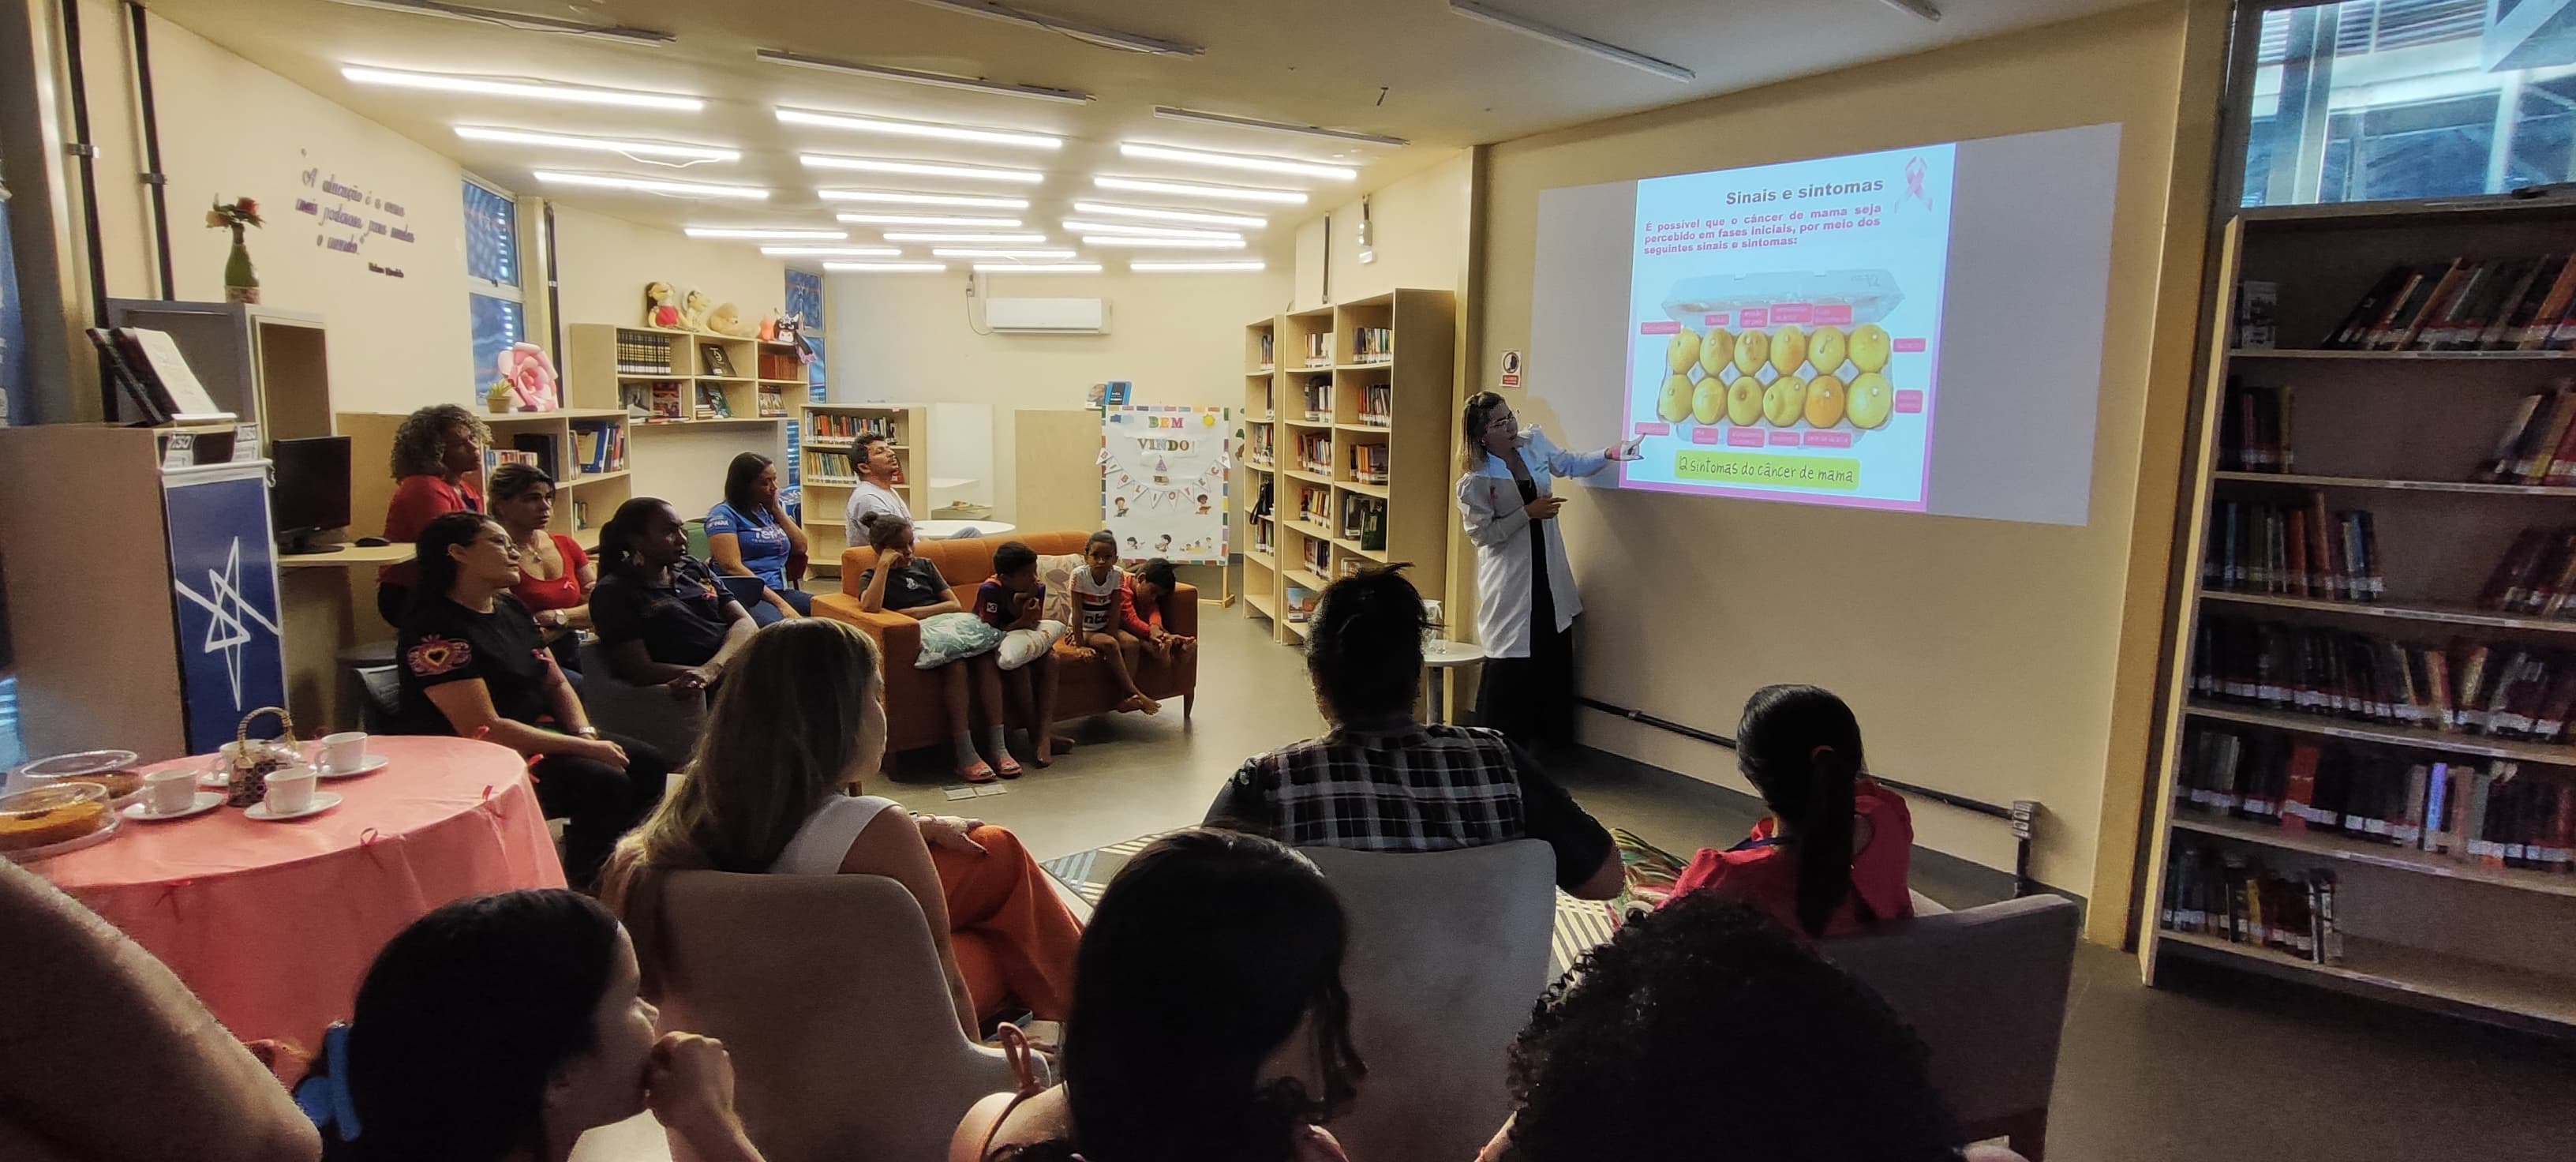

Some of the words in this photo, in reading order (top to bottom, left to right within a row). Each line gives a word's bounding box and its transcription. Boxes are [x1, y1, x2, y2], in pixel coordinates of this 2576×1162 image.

[1726, 189, 1777, 205] Sinais
[1782, 189, 1793, 200] e
[1798, 179, 1884, 198] sintomas
[1645, 231, 1696, 245] percebido
[1698, 231, 1715, 239] em
[1718, 228, 1748, 238] fases
[1799, 222, 1820, 234] por
[1823, 219, 1854, 231] meio
[1858, 217, 1881, 227] dos
[1646, 221, 1653, 231] É
[1657, 219, 1700, 233] possível
[1705, 218, 1725, 228] que
[1743, 213, 1784, 224] câncer
[1788, 210, 1804, 220] de
[1810, 208, 1848, 219] mama
[1855, 204, 1882, 216] seja
[1644, 243, 1694, 256] seguintes
[1697, 240, 1728, 251] sinais
[1742, 237, 1798, 249] sintomas:
[1148, 416, 1184, 429] BEM
[1690, 456, 1739, 475] sintomas
[1741, 461, 1754, 476] do
[1757, 461, 1797, 478] câncer
[1799, 464, 1814, 480] de
[1818, 469, 1854, 483] mama
